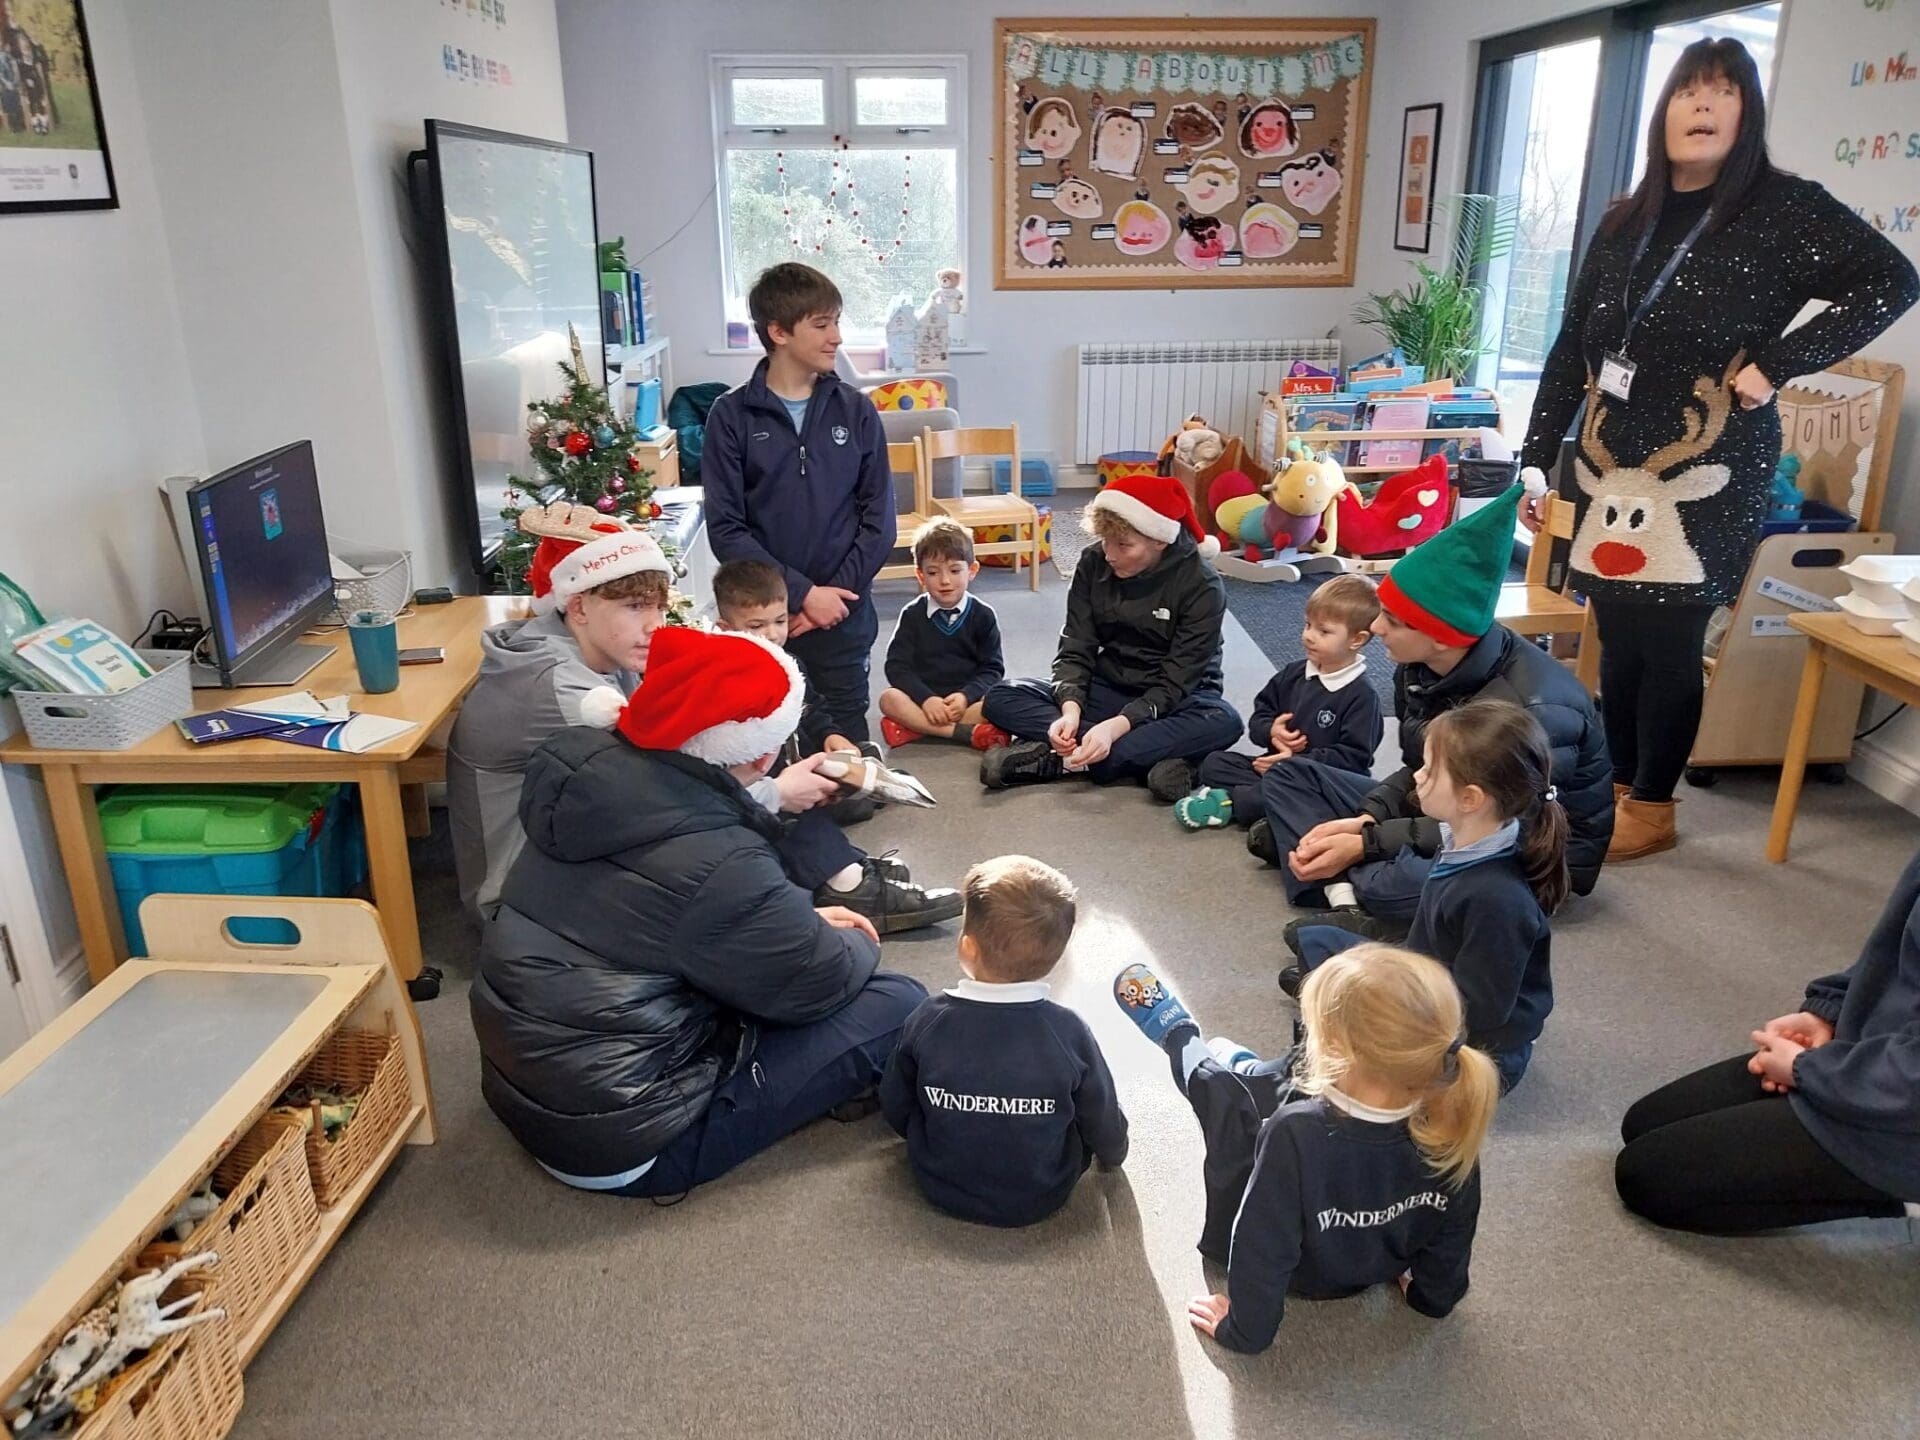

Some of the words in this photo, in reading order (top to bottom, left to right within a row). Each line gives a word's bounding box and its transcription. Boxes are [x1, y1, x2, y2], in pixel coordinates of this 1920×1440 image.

[1017, 43, 1089, 76] ALL
[1137, 57, 1269, 84] ABOUT
[1312, 46, 1356, 76] ME
[582, 551, 618, 575] Merry
